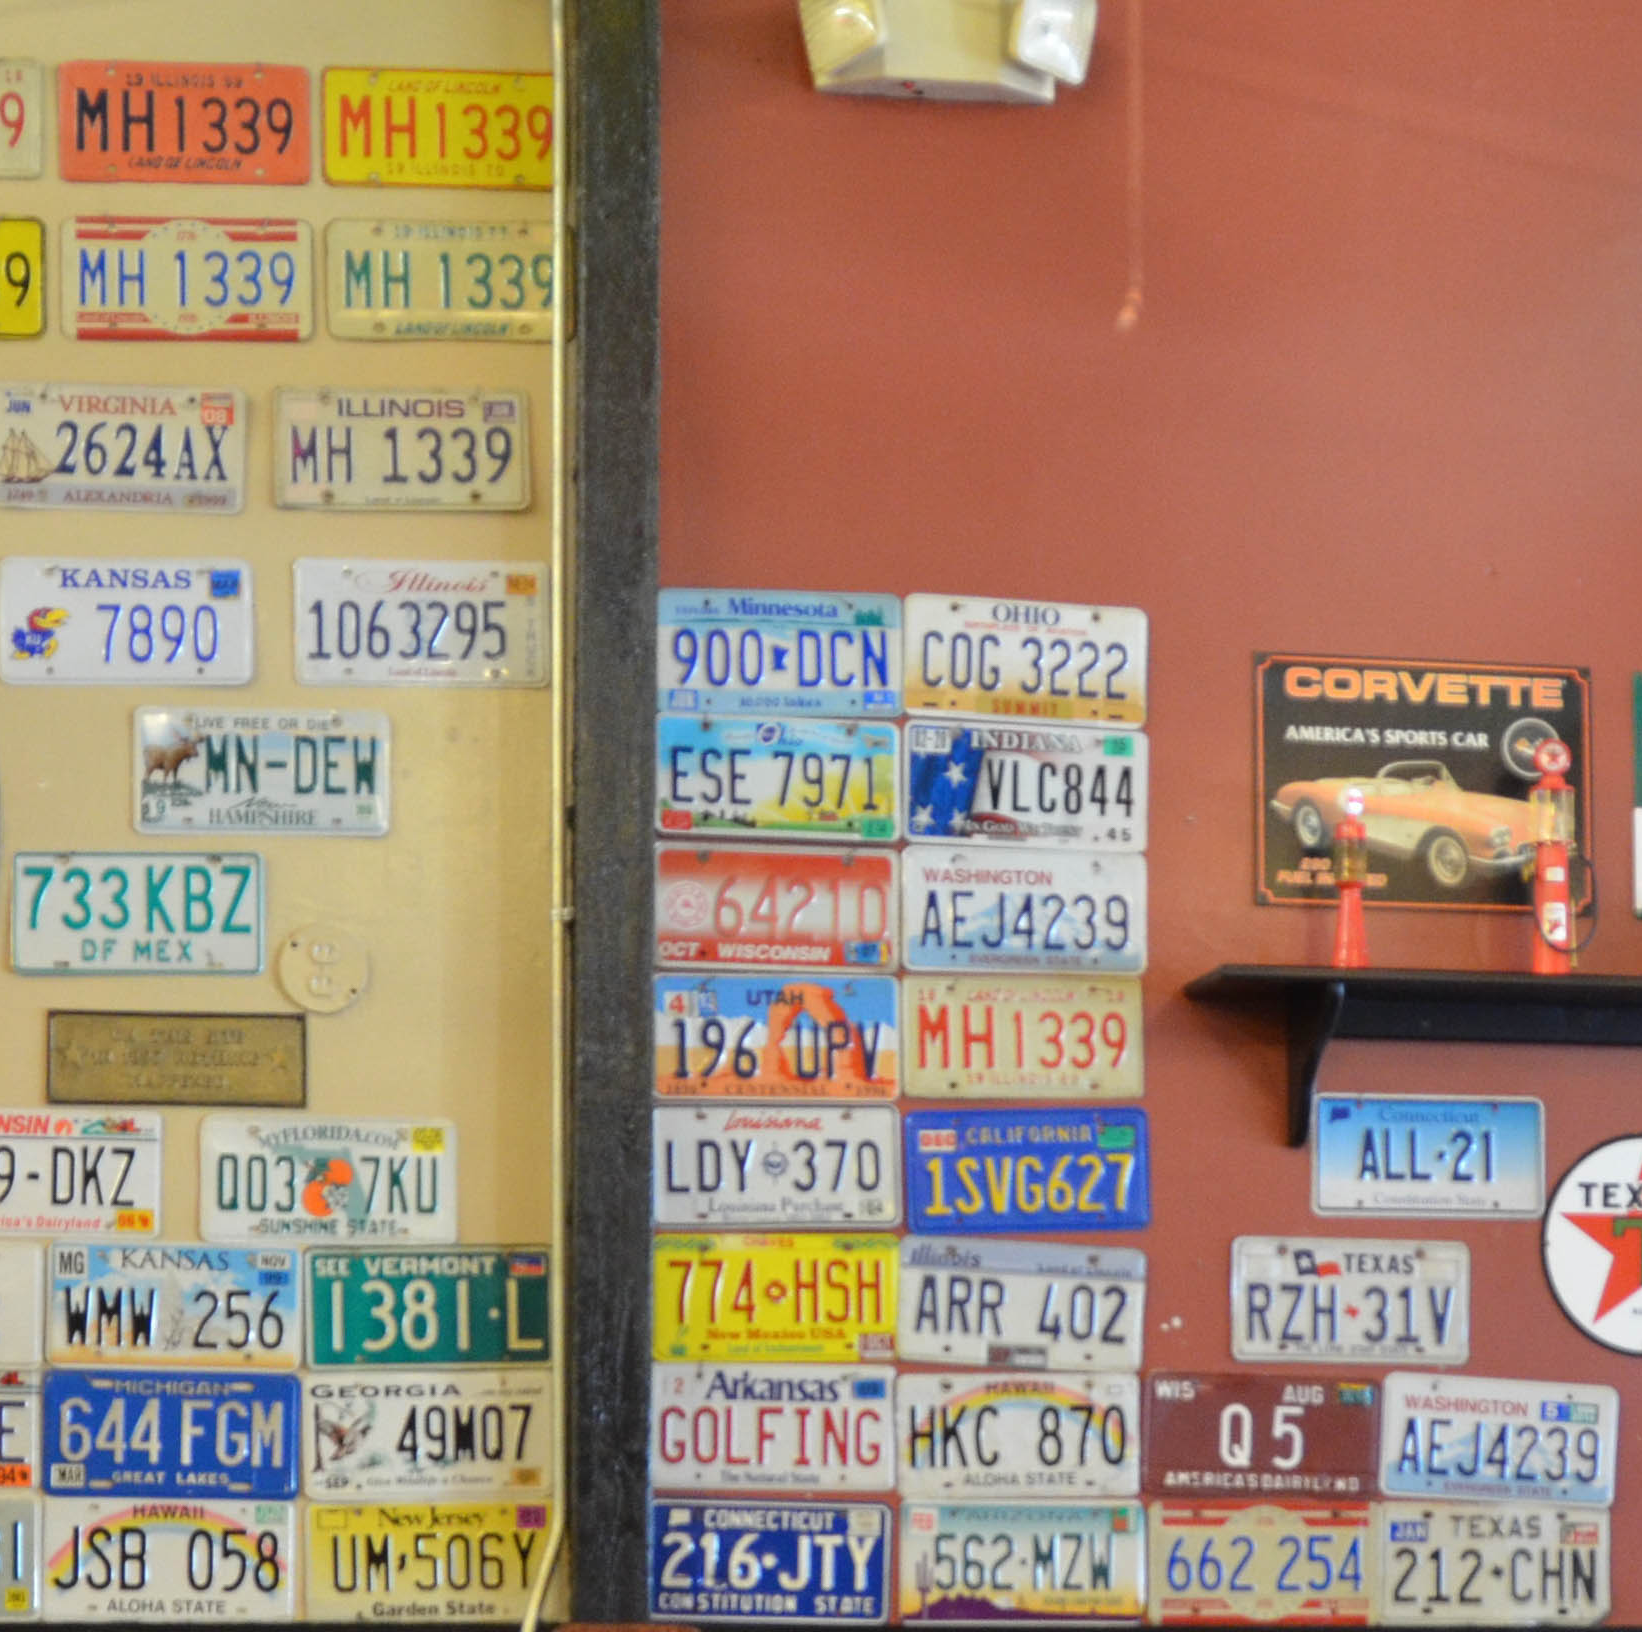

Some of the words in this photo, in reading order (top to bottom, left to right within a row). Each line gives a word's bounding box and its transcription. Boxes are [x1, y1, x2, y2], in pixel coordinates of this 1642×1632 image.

[174, 250, 295, 307] 1339
[337, 400, 465, 418] ILLINOIS
[291, 426, 353, 484] MH
[381, 427, 513, 484] 1339
[59, 567, 192, 590] KANSAS
[992, 603, 1061, 626] OHIO
[96, 604, 219, 664] 7890
[308, 601, 507, 662] 1063295
[673, 629, 765, 688] 900
[798, 630, 889, 687] DCN
[1284, 667, 1564, 708] CORVETTE
[969, 730, 1083, 751] INDIANA
[1285, 725, 1381, 744] AMERICA'S
[1385, 728, 1448, 747] SPORTS
[1452, 732, 1489, 749] CAR
[672, 745, 753, 805] ESE
[772, 750, 880, 811] 7971
[923, 867, 1053, 886] WASHINGTON
[920, 891, 1130, 952] AEJ4239
[81, 938, 117, 963] DF
[134, 938, 193, 962] MEX
[747, 989, 805, 1007] UTAH
[723, 1110, 823, 1132] Louisiana
[666, 1140, 753, 1194] LDY
[793, 1140, 882, 1192] 370
[924, 1153, 1134, 1217] 1SVG627
[37, 1215, 101, 1231] Dairyland
[315, 1259, 350, 1276] SEE
[364, 1256, 495, 1276] VERMONT
[1344, 1253, 1415, 1276] TEXAS
[669, 1260, 756, 1325] 774
[794, 1259, 882, 1325] HSH
[193, 1290, 285, 1350] 256
[914, 1276, 1004, 1337] ARR
[1037, 1284, 1128, 1345] 402
[114, 1380, 231, 1395] MICHIGAN
[310, 1385, 461, 1399] GEORGIA
[1405, 1393, 1528, 1418] WASHINGTON
[60, 1400, 160, 1464] 644
[180, 1402, 283, 1467] FGM
[661, 1407, 882, 1467] GOLFING
[909, 1405, 1000, 1468] HKC
[1038, 1406, 1127, 1466] 870
[1398, 1418, 1600, 1482] AEJ4239
[133, 1505, 205, 1519] HAWAII
[704, 1508, 836, 1530] CONNECTICUT
[53, 1527, 146, 1592] JSB
[188, 1530, 280, 1593] 058
[1393, 1549, 1484, 1604] 212
[1510, 1551, 1598, 1603] CHN
[107, 1599, 165, 1614] ALOHA
[172, 1600, 226, 1614] STATE
[372, 1602, 431, 1618] Garden
[439, 1602, 496, 1617] State
